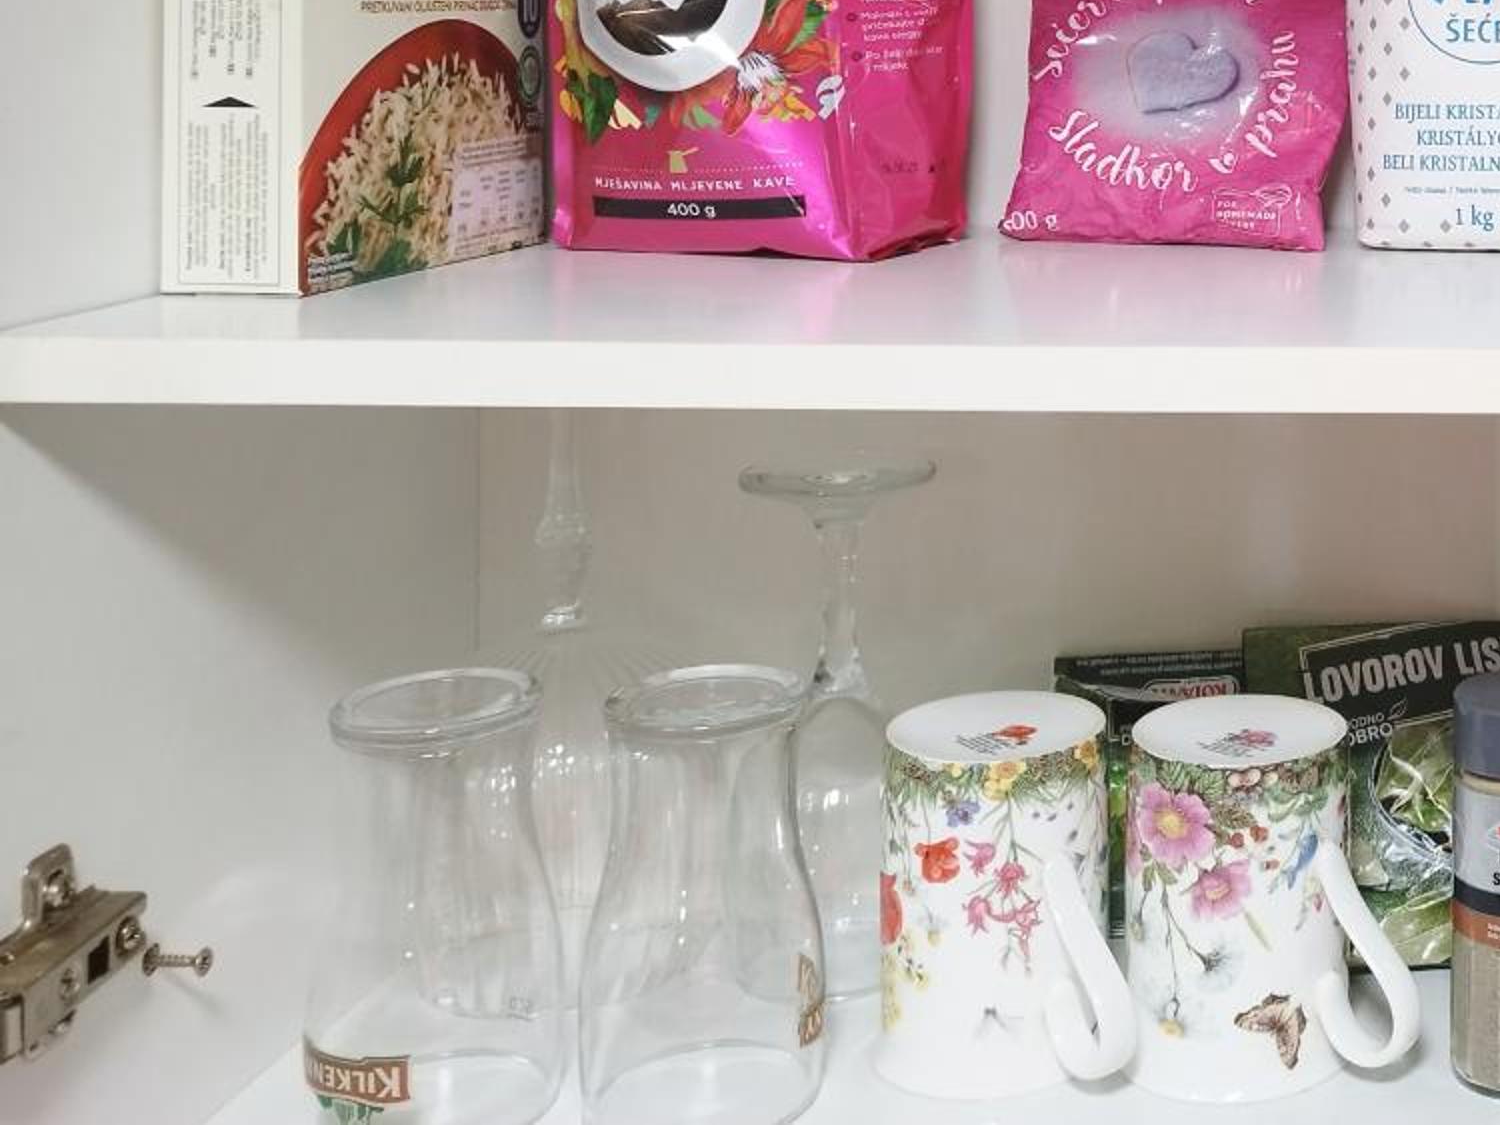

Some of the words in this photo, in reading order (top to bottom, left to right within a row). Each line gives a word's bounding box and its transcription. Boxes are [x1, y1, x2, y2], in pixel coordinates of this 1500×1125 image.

[1394, 104, 1441, 124] BIJELI
[1383, 155, 1415, 172] BELI
[753, 176, 797, 189] KAVE
[667, 202, 700, 216] 400
[704, 204, 716, 218] g
[1456, 208, 1463, 225] 1
[1471, 204, 1495, 232] kg
[1303, 645, 1445, 704] LOVOROV
